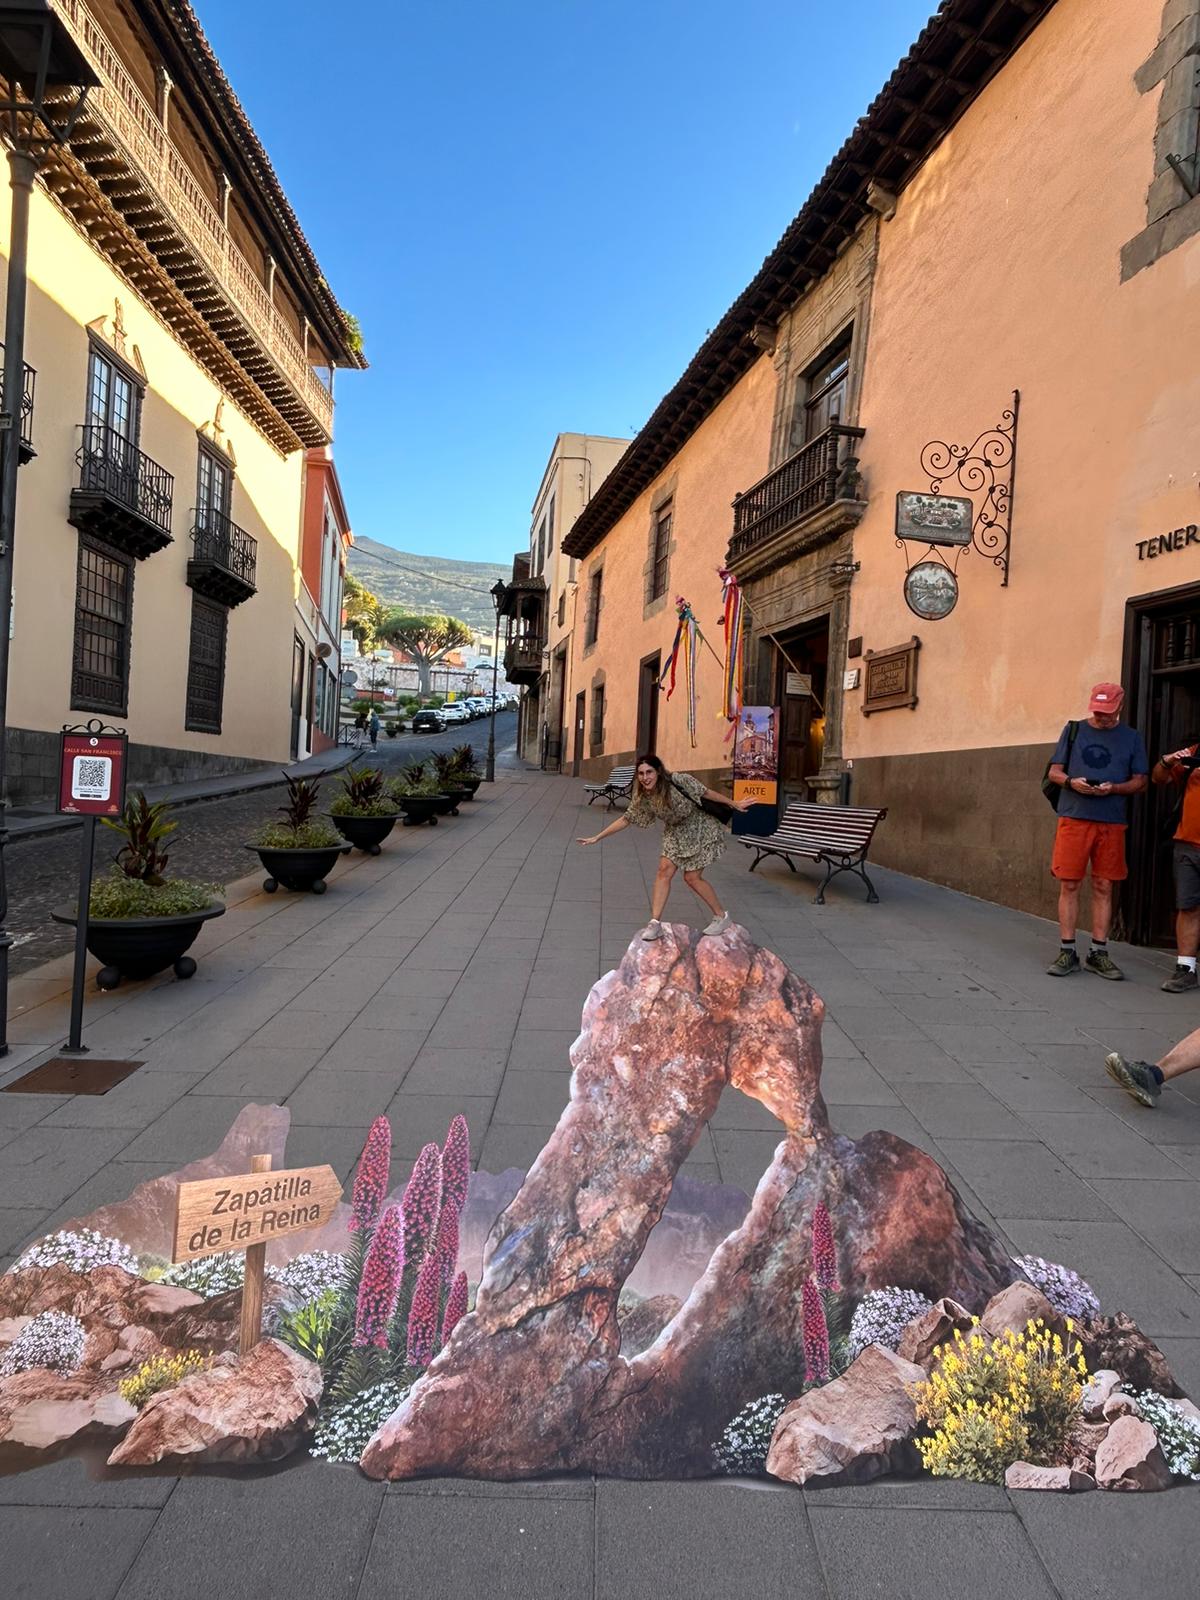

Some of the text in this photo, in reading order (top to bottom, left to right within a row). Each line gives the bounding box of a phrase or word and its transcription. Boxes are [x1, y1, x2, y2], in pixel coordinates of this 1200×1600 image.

[743, 786, 766, 796] ARTE
[212, 1176, 312, 1215] Zapatilla
[189, 1203, 320, 1251] de la Reina
